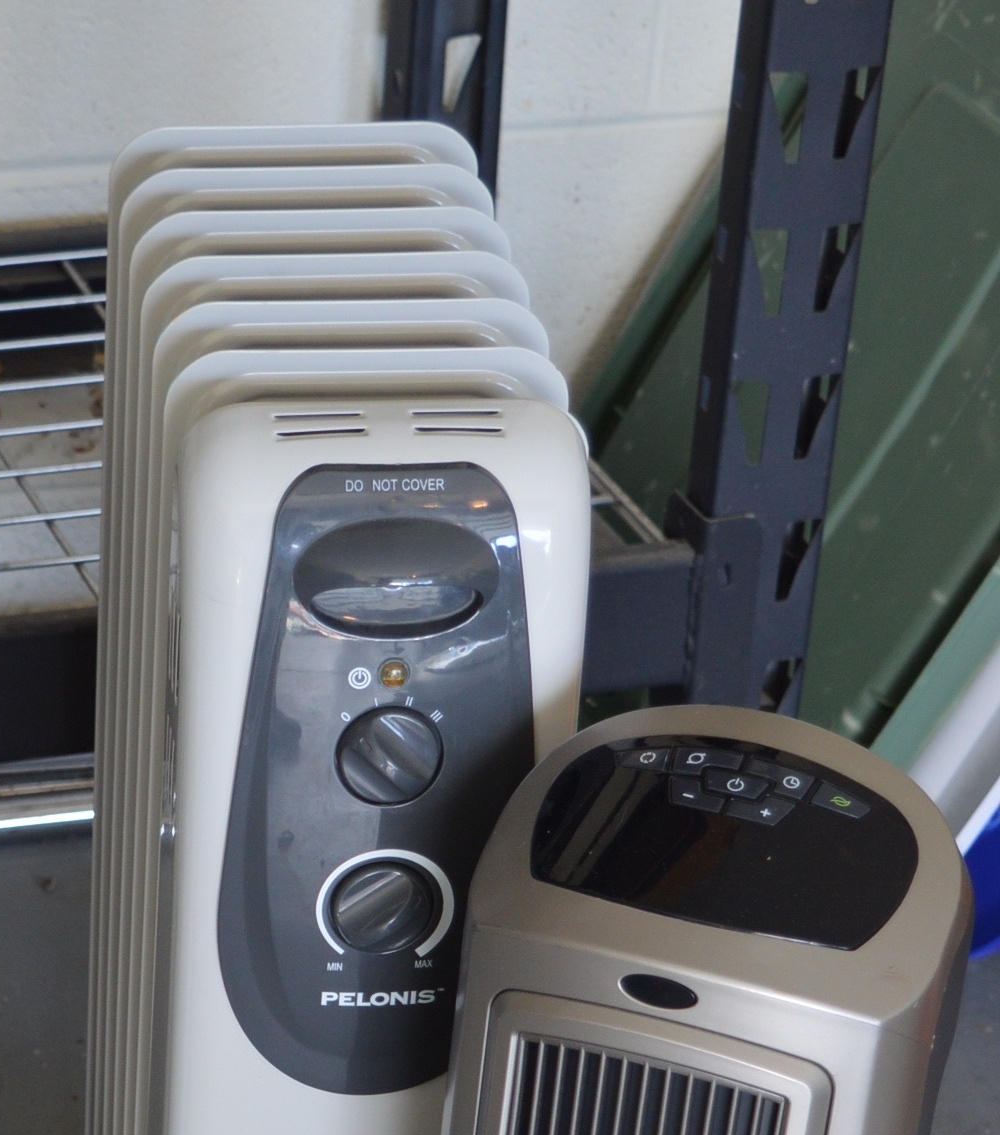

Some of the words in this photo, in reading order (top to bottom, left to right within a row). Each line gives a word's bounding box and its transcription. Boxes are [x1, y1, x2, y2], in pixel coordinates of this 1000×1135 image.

[345, 480, 364, 492] DO
[372, 479, 398, 491] NOT
[402, 478, 445, 491] COVER
[326, 962, 343, 972] MIN
[414, 959, 433, 969] MAX
[321, 989, 436, 1007] PELONIS
